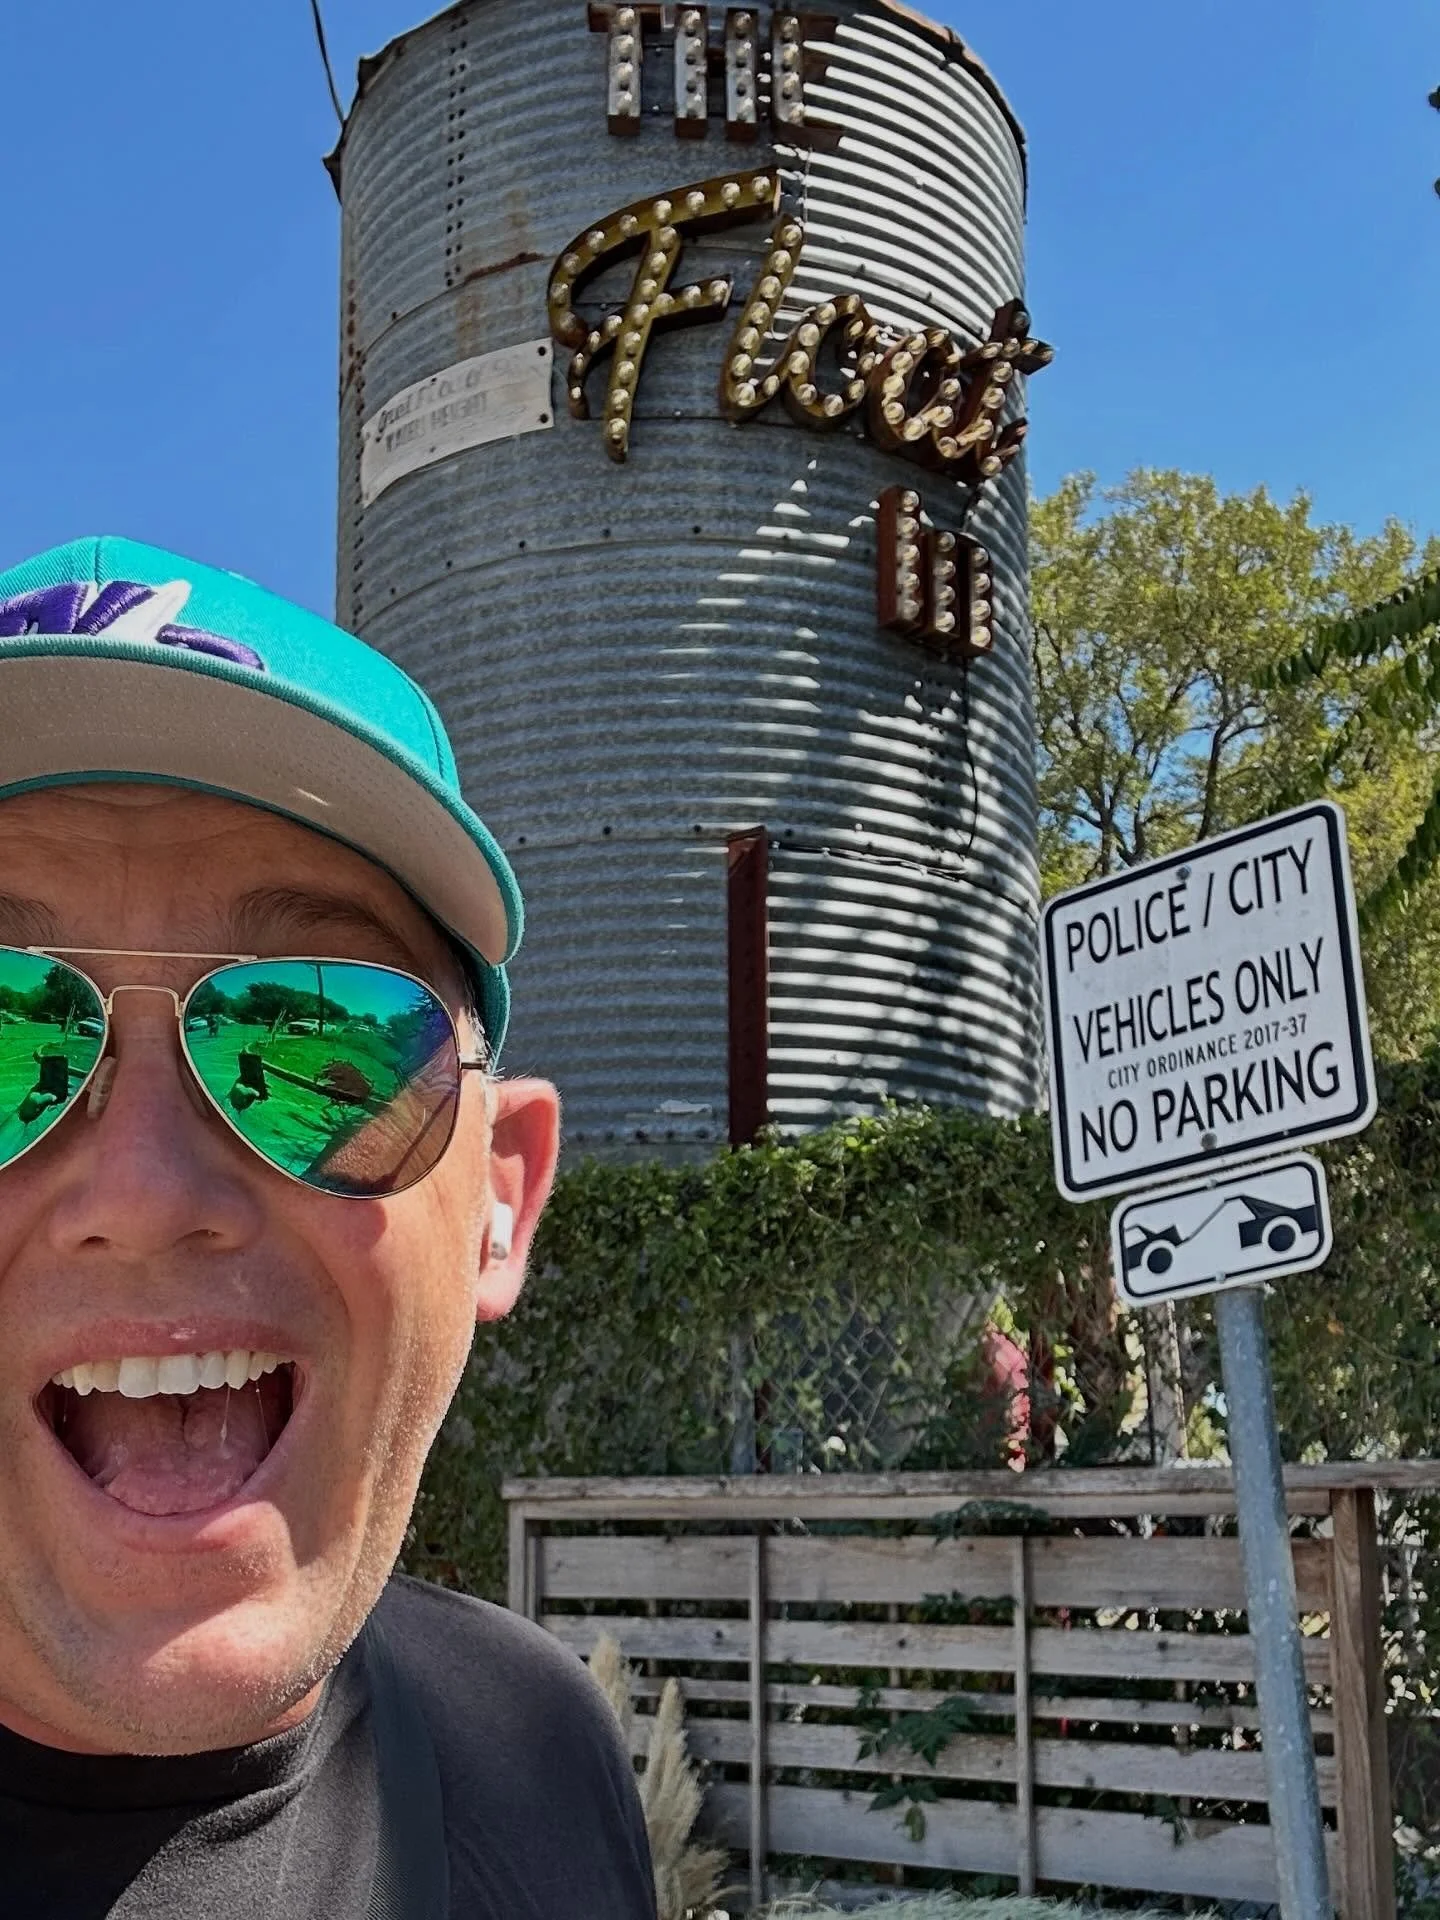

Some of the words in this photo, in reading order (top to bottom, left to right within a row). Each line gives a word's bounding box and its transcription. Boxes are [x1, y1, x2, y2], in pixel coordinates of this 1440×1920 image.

[588, 0, 842, 145] THE
[548, 166, 1054, 484] Float
[1066, 883, 1190, 973] POLICE
[1228, 838, 1314, 916] CITY
[1073, 970, 1225, 1064] VEHICLES
[1235, 936, 1324, 1015] ONLY
[1107, 1063, 1141, 1090] CITY
[1147, 1033, 1238, 1081] ORDINANCE
[1244, 1013, 1308, 1048] 2017-37
[1080, 1099, 1138, 1163] NO
[1153, 1041, 1341, 1143] PARKING
